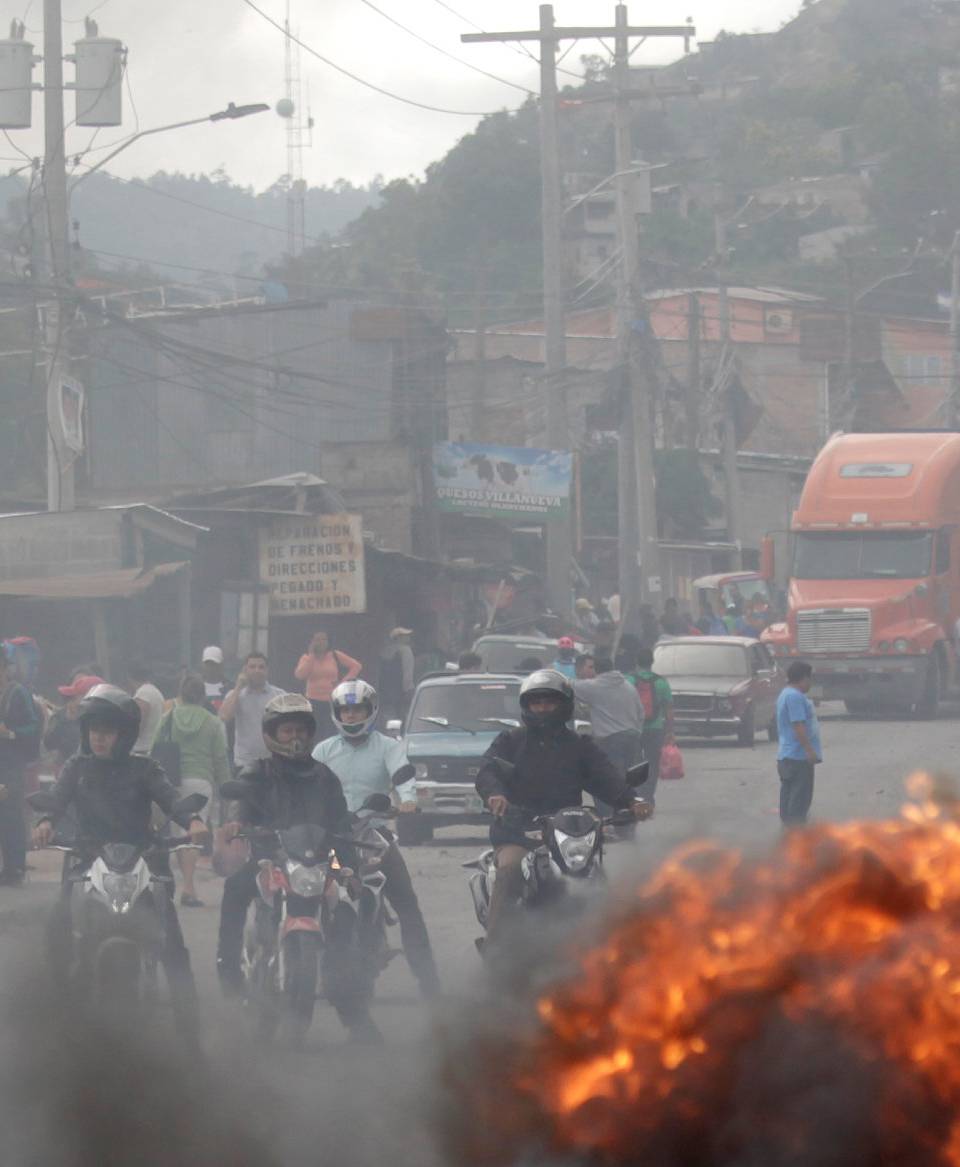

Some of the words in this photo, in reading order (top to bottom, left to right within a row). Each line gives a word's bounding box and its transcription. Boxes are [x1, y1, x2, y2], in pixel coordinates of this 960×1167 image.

[436, 487, 484, 501] QUESOS
[486, 490, 562, 507] VILLANUEVA
[268, 546, 285, 559] DE
[290, 543, 342, 557] FRENOS
[268, 560, 357, 576] DIRECCIONES
